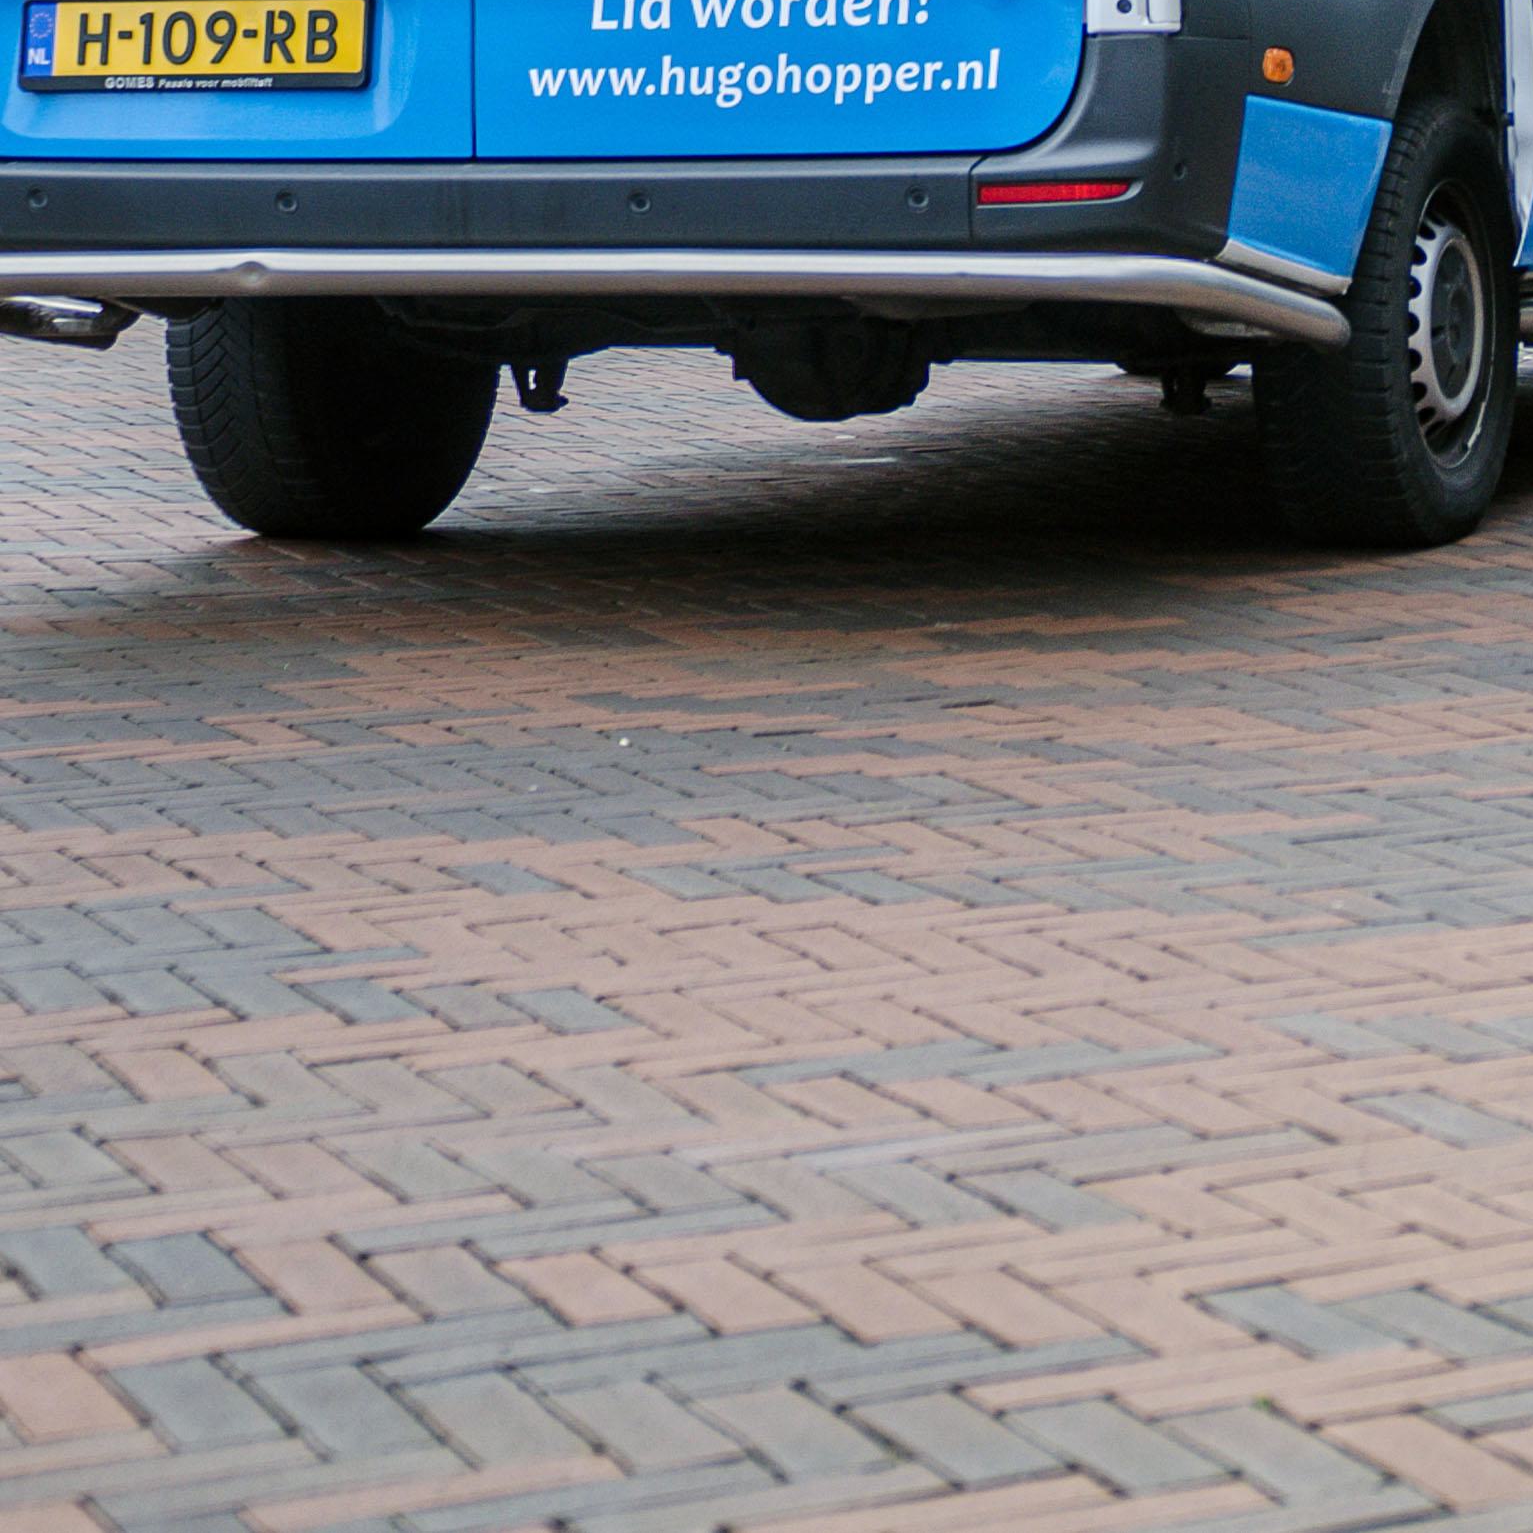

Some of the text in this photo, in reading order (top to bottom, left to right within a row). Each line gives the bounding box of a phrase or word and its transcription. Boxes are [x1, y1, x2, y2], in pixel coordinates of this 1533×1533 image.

[77, 10, 338, 66] H-109-RB
[28, 48, 50, 66] NL
[104, 76, 155, 90] GOMES
[195, 79, 219, 88] voor
[528, 48, 1000, 108] www.hugohopper.nl
